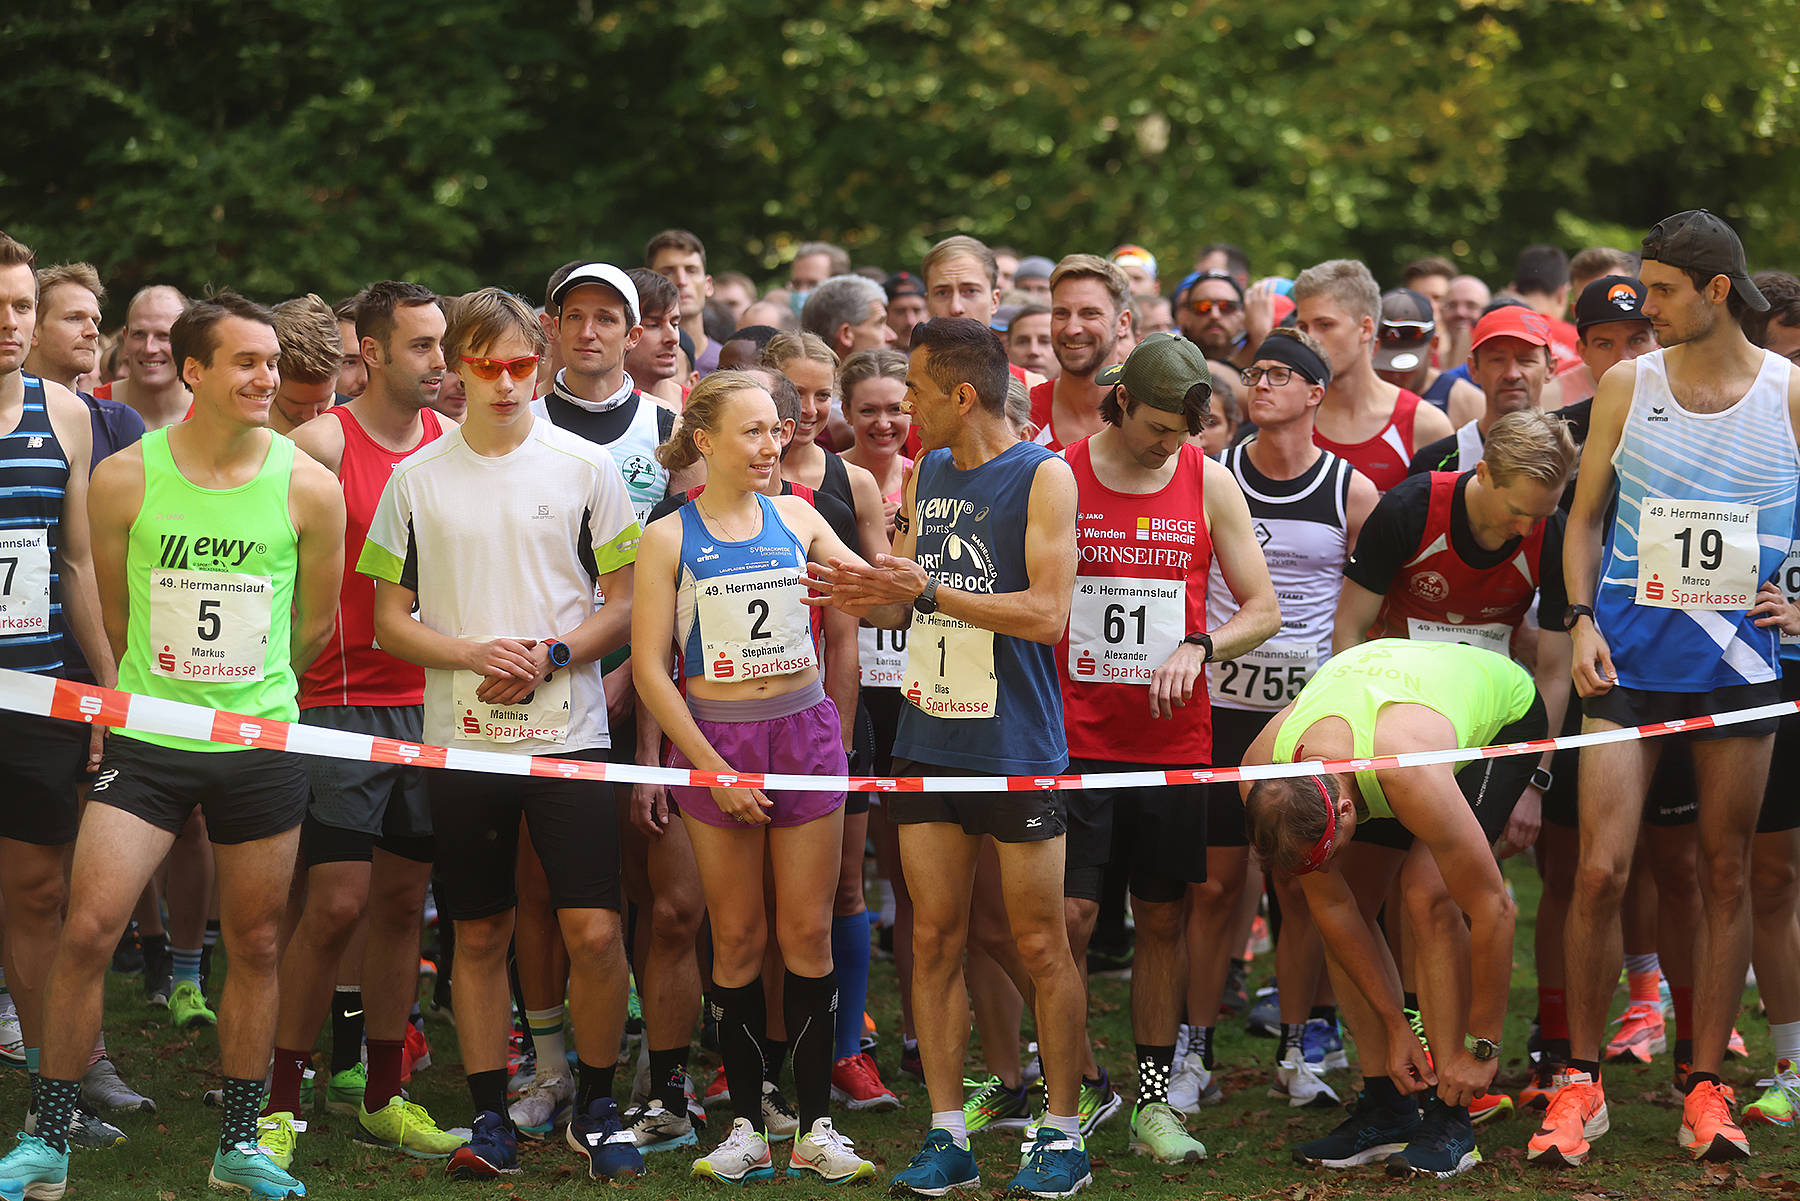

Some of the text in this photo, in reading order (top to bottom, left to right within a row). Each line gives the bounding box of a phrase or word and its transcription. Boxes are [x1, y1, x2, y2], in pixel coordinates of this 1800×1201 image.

[1649, 506, 1750, 524] 49. Hermannslauf
[1151, 517, 1197, 534] BIGGE
[1083, 527, 1127, 540] Wenden
[1151, 531, 1196, 546] ENERGIE
[1673, 527, 1724, 571] 19
[696, 553, 720, 563] erima
[1750, 564, 1758, 574] A
[159, 577, 265, 593] 49. Hermannslauf
[1418, 580, 1442, 595] TSVE
[1681, 575, 1711, 587] Marco
[43, 586, 49, 596] A
[704, 585, 723, 597] 49.
[1080, 584, 1178, 599] 49. Hermannslauf
[1671, 589, 1747, 606] Sparkasse
[197, 599, 222, 642] 5
[747, 598, 772, 641] 2
[915, 613, 927, 625] 49.
[1103, 602, 1146, 645] 61
[804, 625, 810, 635] A
[1417, 623, 1505, 642] 49. Hermannslauf
[261, 635, 267, 645] A
[190, 646, 225, 658] Markus
[741, 644, 785, 659] Stephanie
[937, 635, 946, 678] 1
[1104, 649, 1148, 662] Alexander
[182, 660, 257, 678] Sparkasse
[742, 656, 811, 678] Sparkasse
[876, 657, 902, 666] Larissa
[989, 671, 995, 681] A
[1219, 660, 1307, 702] 2755
[934, 683, 950, 695] Elias
[562, 700, 569, 710] A
[925, 696, 989, 714] Sparkasse
[490, 709, 529, 722] Matthias
